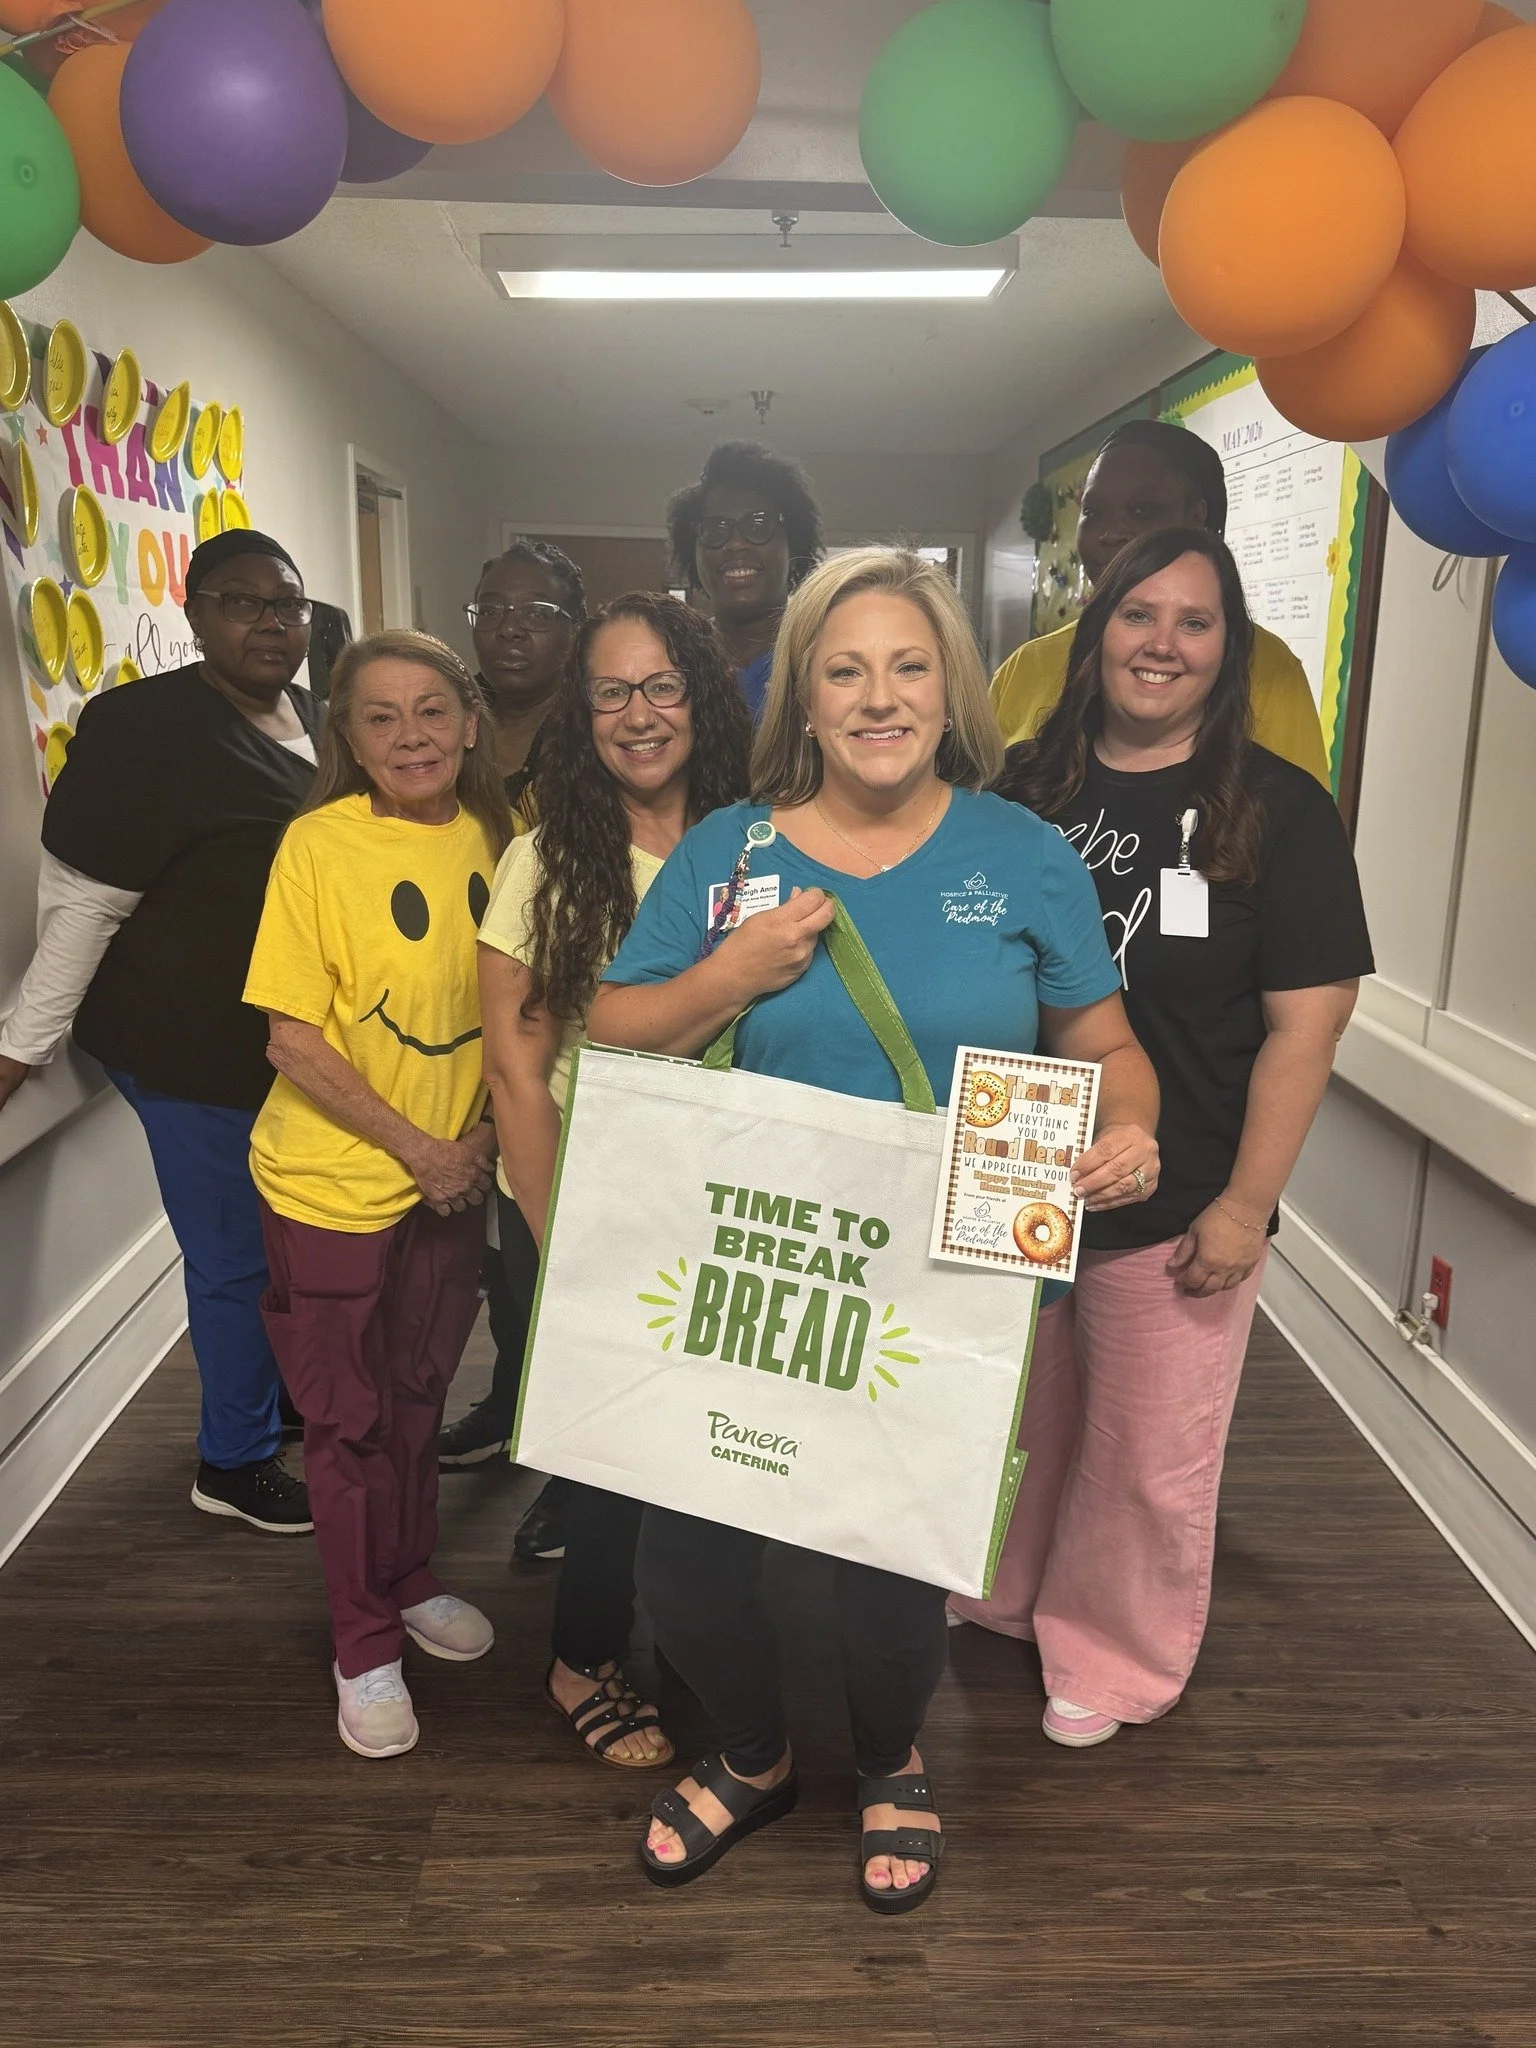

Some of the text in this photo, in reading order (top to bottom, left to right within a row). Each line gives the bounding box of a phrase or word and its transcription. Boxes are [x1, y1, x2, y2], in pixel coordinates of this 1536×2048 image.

[1222, 418, 1263, 452] MAY 2026
[108, 520, 190, 607] YOU
[942, 898, 1008, 915] Care of the
[945, 911, 999, 927] Piedmont
[1005, 1074, 1080, 1108] Thanks!
[1008, 1111, 1069, 1130] EVERYTHING
[1030, 1102, 1049, 1115] FOR
[1018, 1126, 1056, 1142] YOU DO
[963, 1130, 1074, 1168] Round Here!
[964, 1156, 1068, 1182] WE APPRECIATE YOU!
[973, 1169, 1056, 1193] Happy Nursing
[979, 1181, 1048, 1201] Home Week!
[986, 1195, 1001, 1203] friends
[704, 1181, 890, 1250] TIME TO
[954, 1218, 1009, 1238] Care of the
[955, 1230, 1000, 1249] Piedmont
[712, 1224, 871, 1289] BREAK
[683, 1262, 872, 1393] BREAD
[707, 1410, 799, 1458] Panera
[711, 1445, 790, 1477] CATERING
